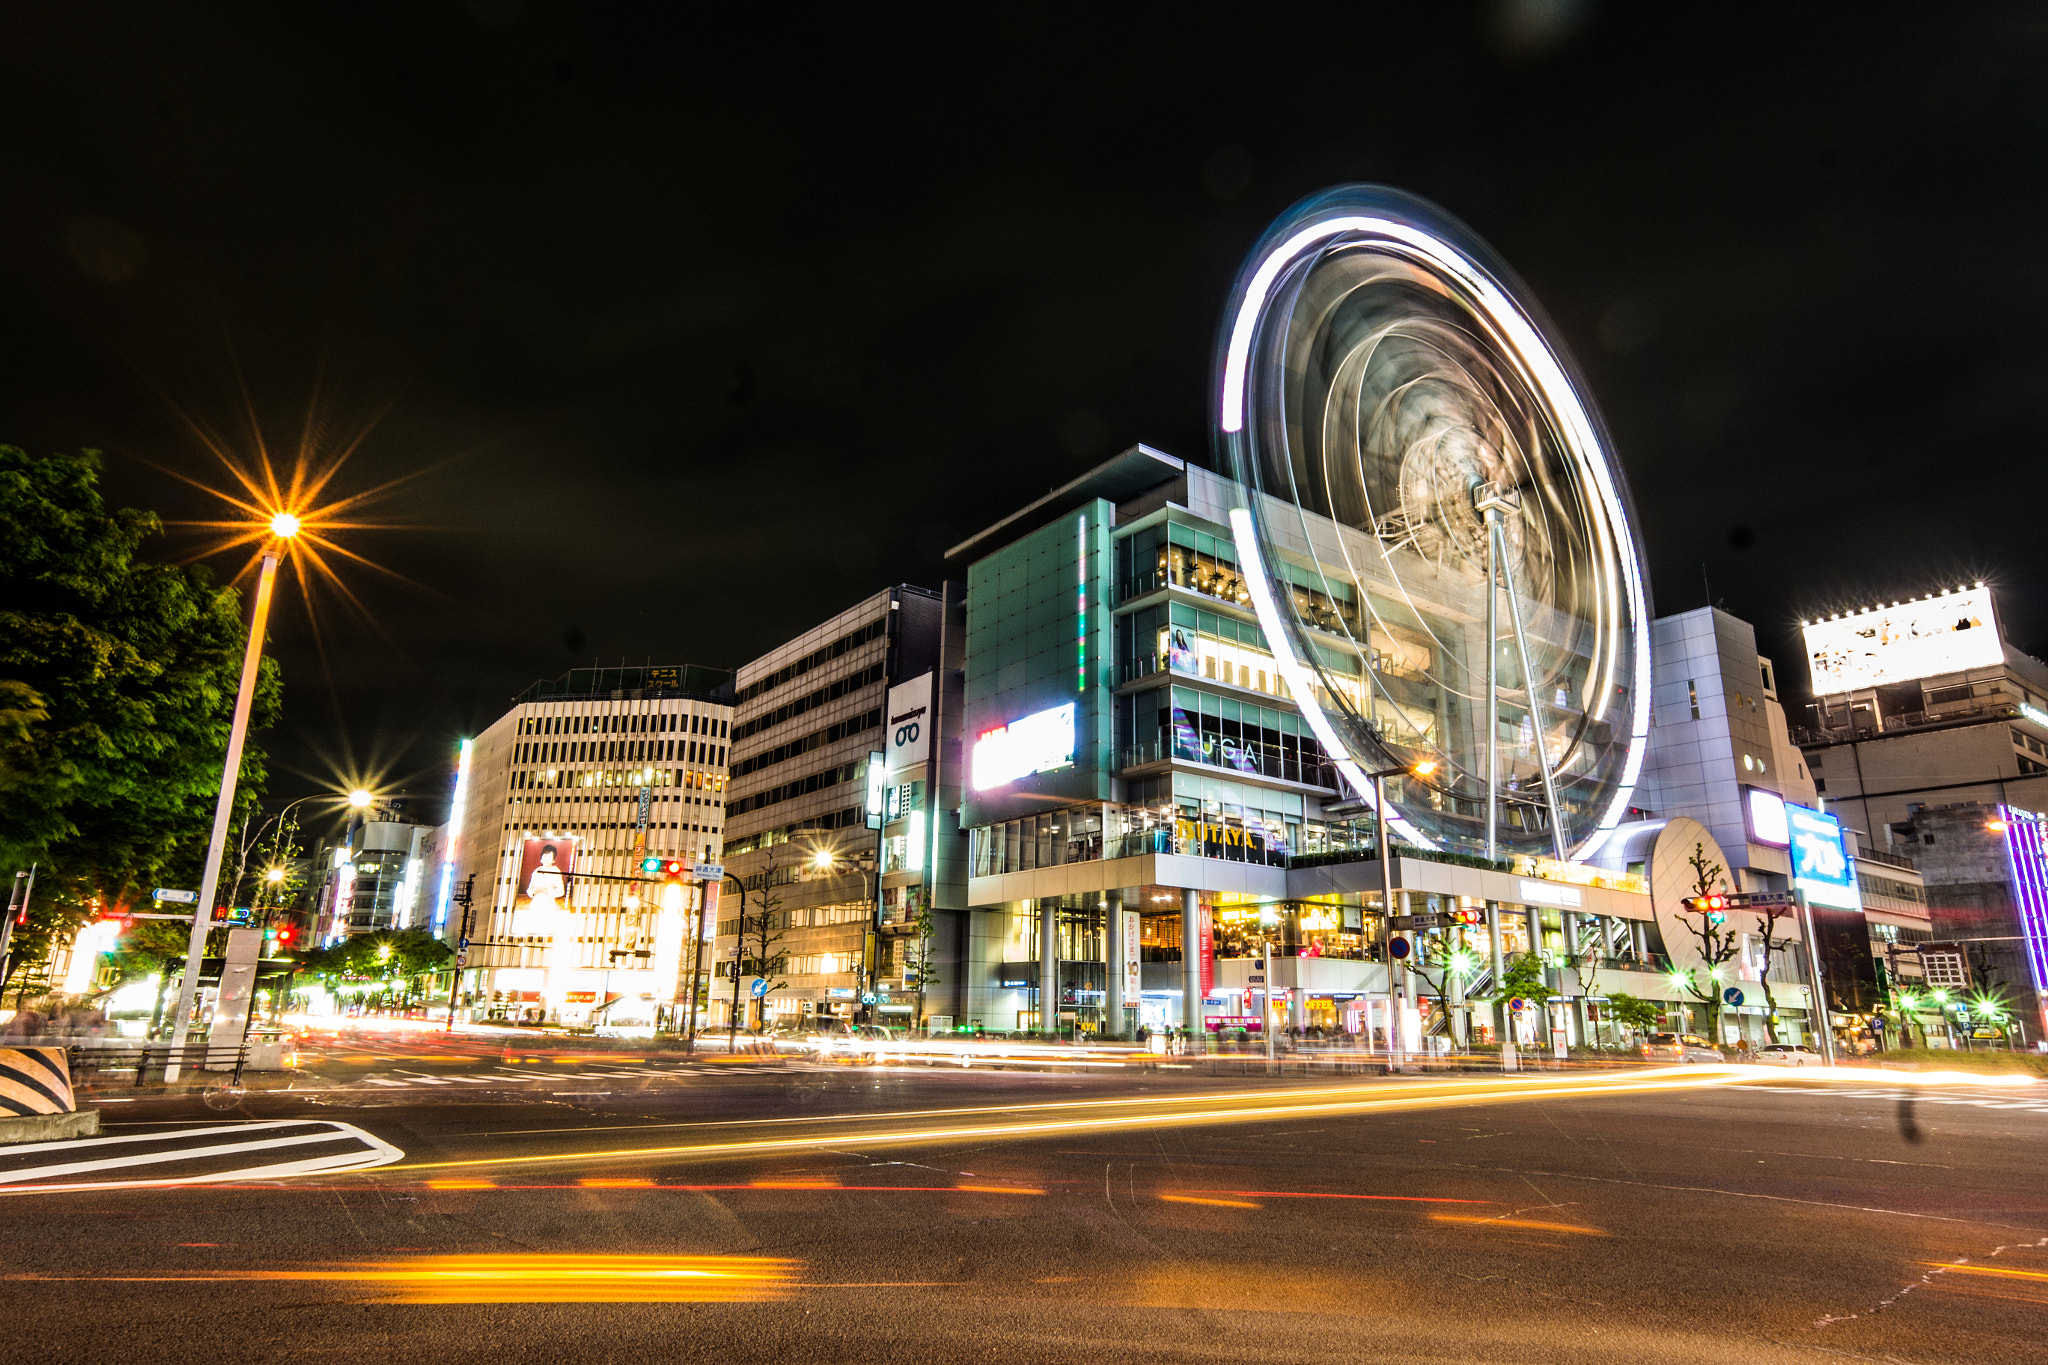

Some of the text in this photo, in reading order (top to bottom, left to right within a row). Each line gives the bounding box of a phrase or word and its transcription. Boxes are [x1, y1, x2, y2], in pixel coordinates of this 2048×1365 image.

[651, 669, 678, 678] テニス
[648, 680, 679, 688] スクール
[1176, 727, 1258, 765] FUGA
[216, 906, 250, 919] PRCO
[1874, 1019, 1882, 1028] P
